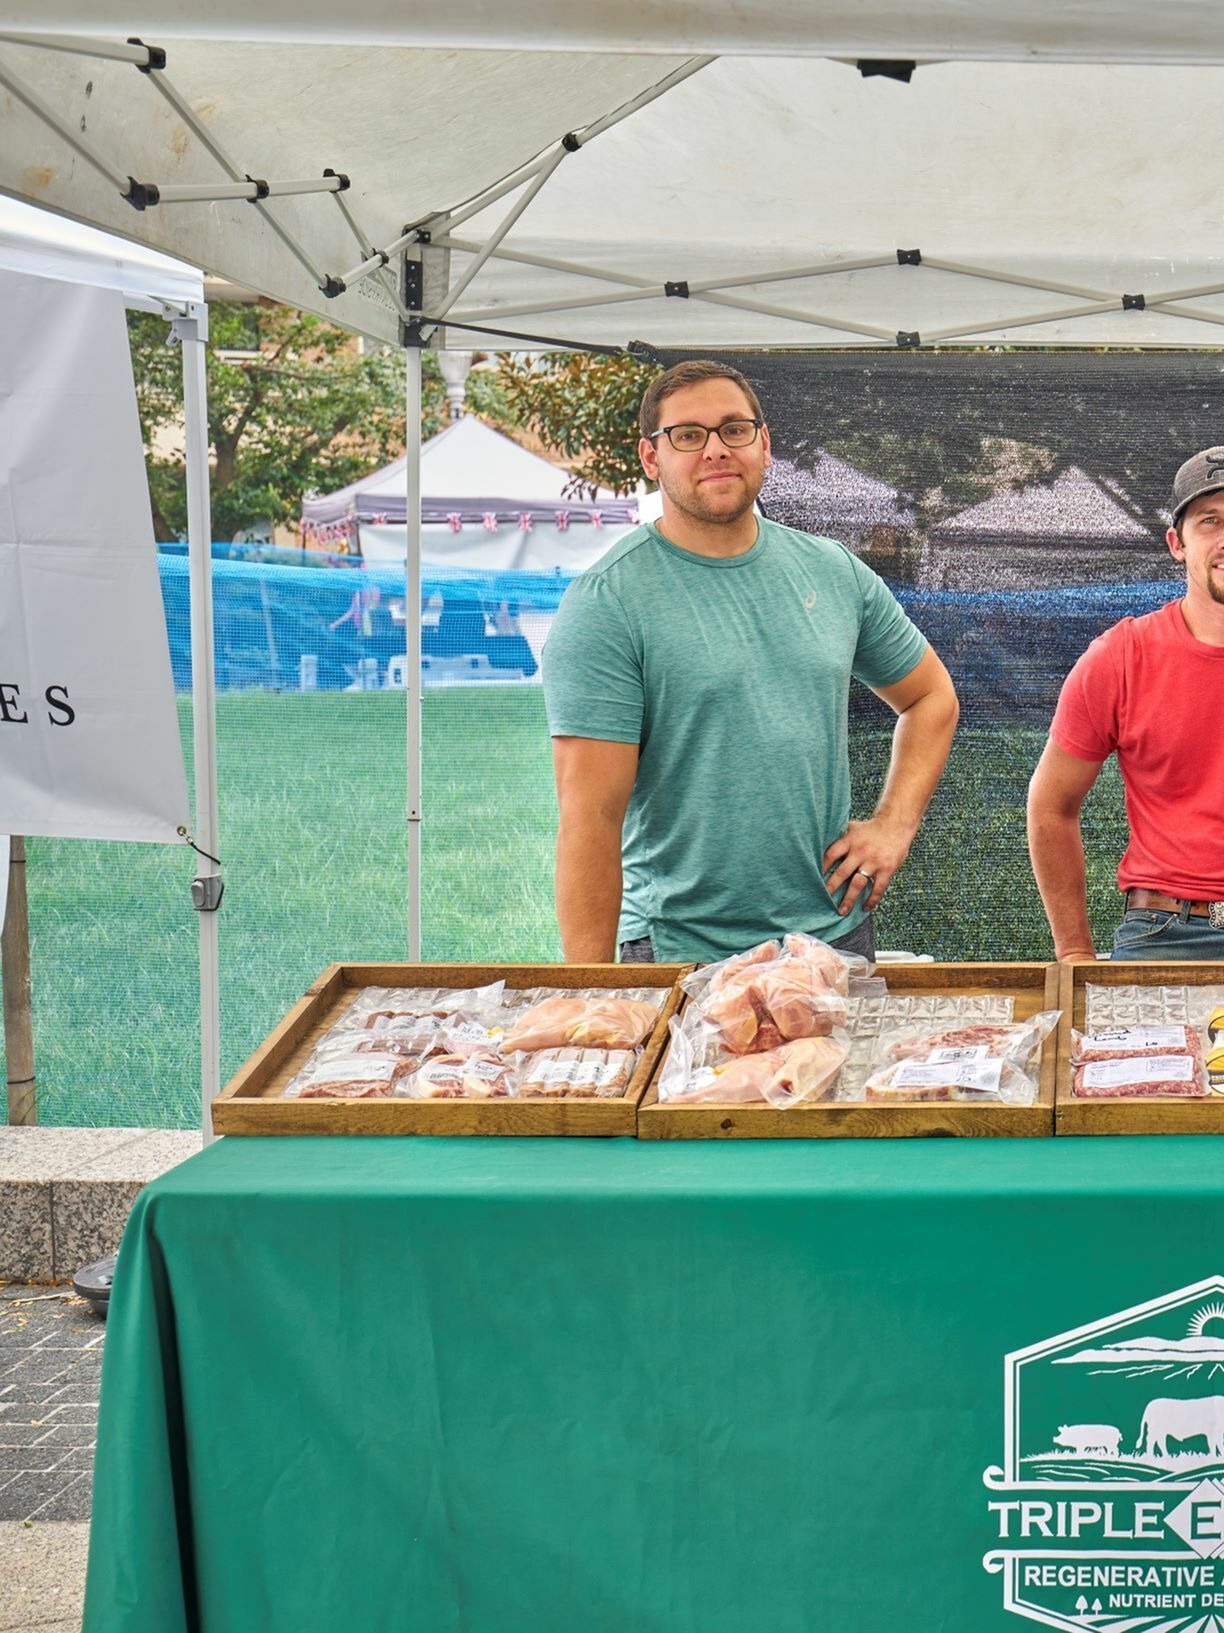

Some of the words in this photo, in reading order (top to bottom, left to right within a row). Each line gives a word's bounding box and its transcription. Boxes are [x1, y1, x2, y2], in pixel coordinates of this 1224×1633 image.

[987, 1500, 1165, 1539] TRIPLE
[1190, 1501, 1223, 1540] E
[1025, 1565, 1215, 1588] REGENERATIVE
[1108, 1594, 1197, 1608] NUTRIENT
